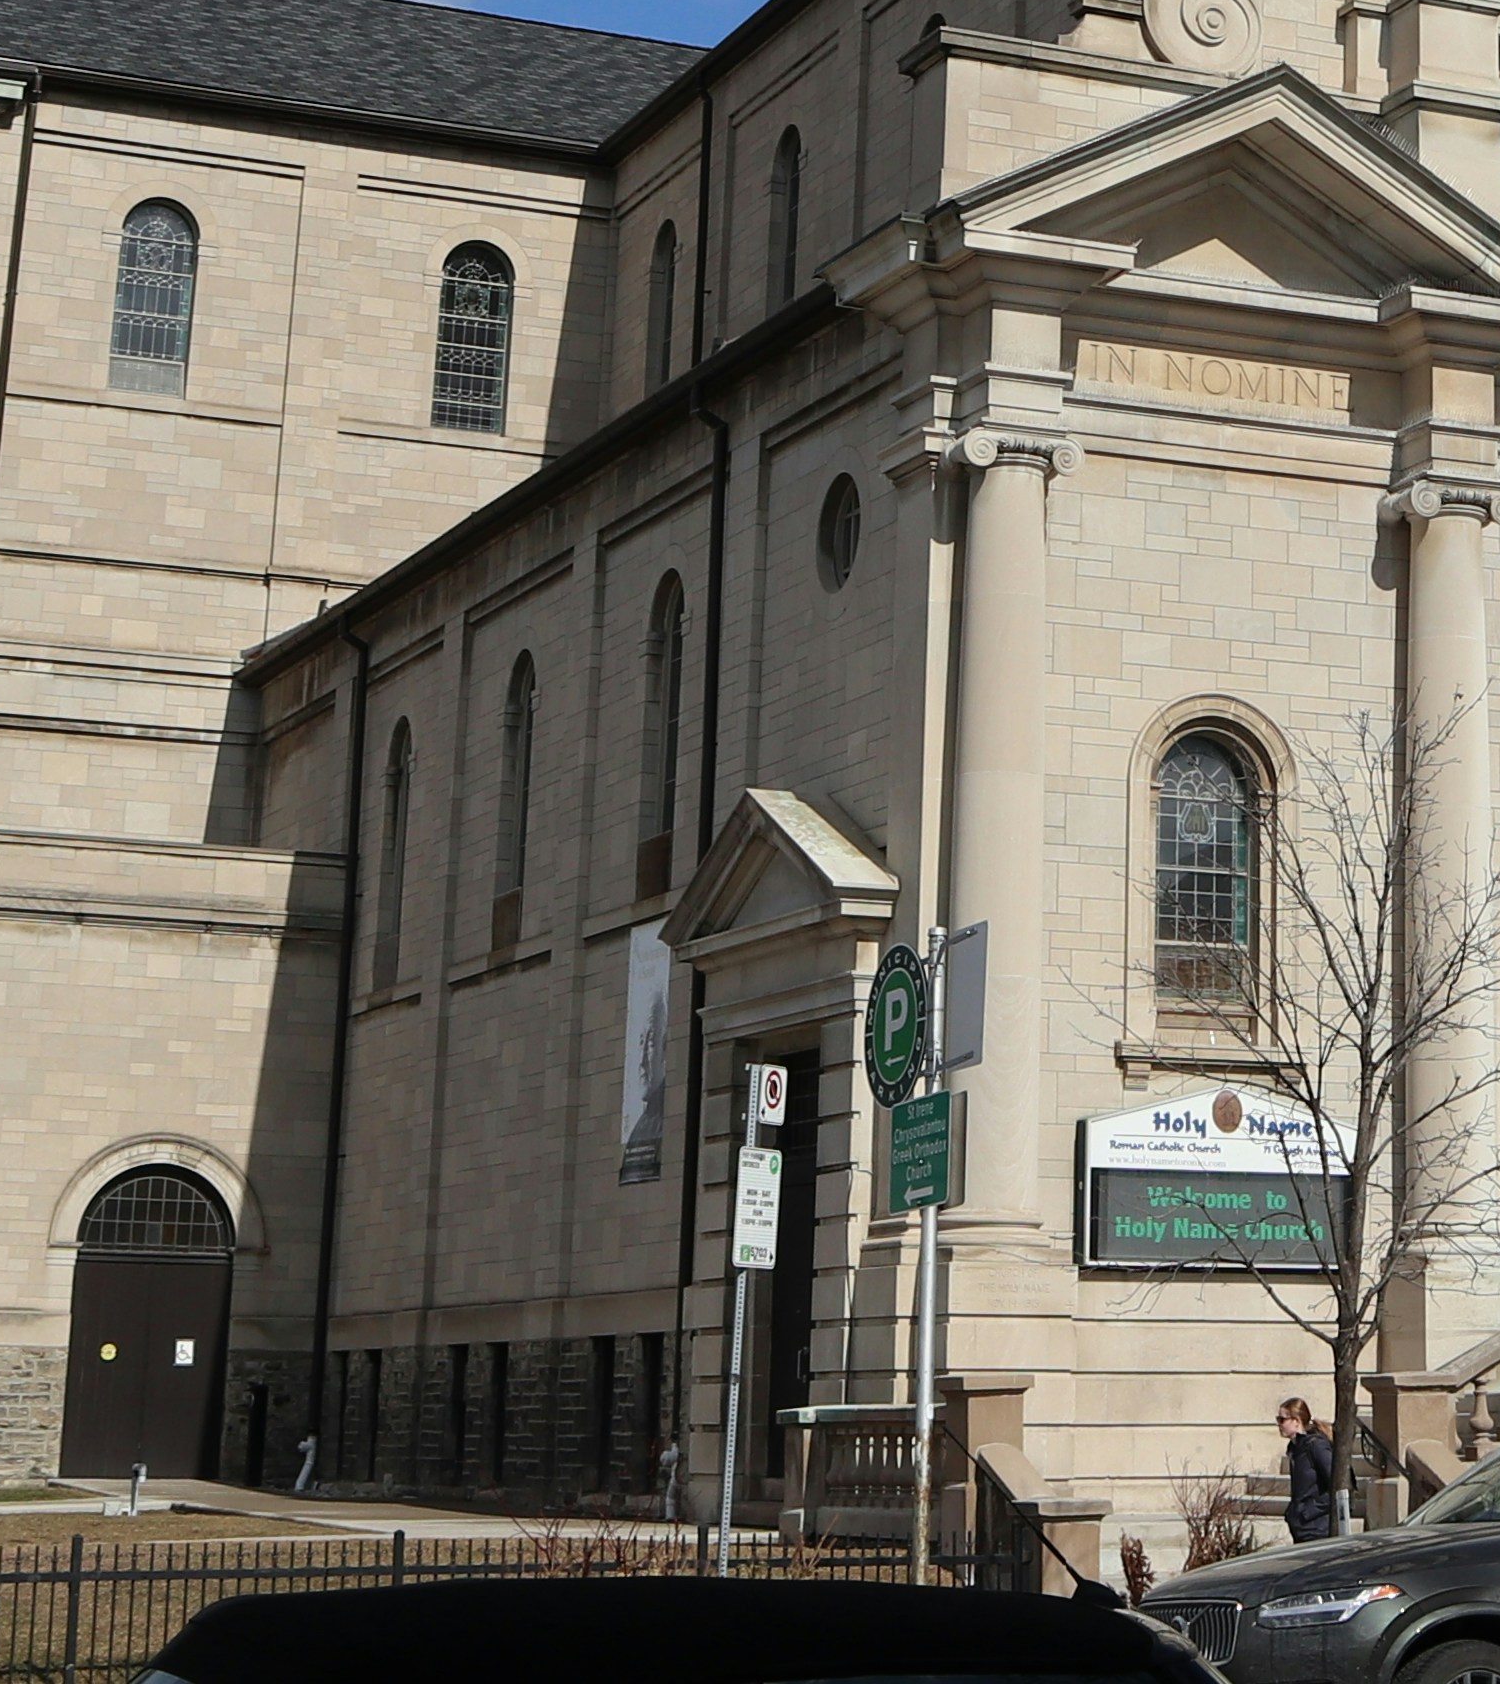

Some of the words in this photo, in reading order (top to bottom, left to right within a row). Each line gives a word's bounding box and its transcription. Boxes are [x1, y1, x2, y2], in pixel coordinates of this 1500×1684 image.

[1088, 344, 1137, 385] IN
[1163, 353, 1354, 413] NOMINE
[867, 951, 925, 1026] MUNICIPAL
[884, 987, 909, 1052] P
[866, 1036, 922, 1101] PARKING
[916, 1101, 934, 1118] Irene
[1153, 1110, 1206, 1139] Holy
[1246, 1114, 1313, 1137] Name
[893, 1146, 912, 1165] Greek
[914, 1138, 947, 1159] Orthodox
[1109, 1140, 1145, 1150] Roman
[1147, 1141, 1184, 1152] Catholic
[1187, 1142, 1221, 1153] Church
[906, 1161, 932, 1182] Church
[1147, 1186, 1252, 1209] Welcome
[1266, 1190, 1287, 1210] to
[1115, 1216, 1167, 1243] Holy
[1173, 1217, 1239, 1240] Name
